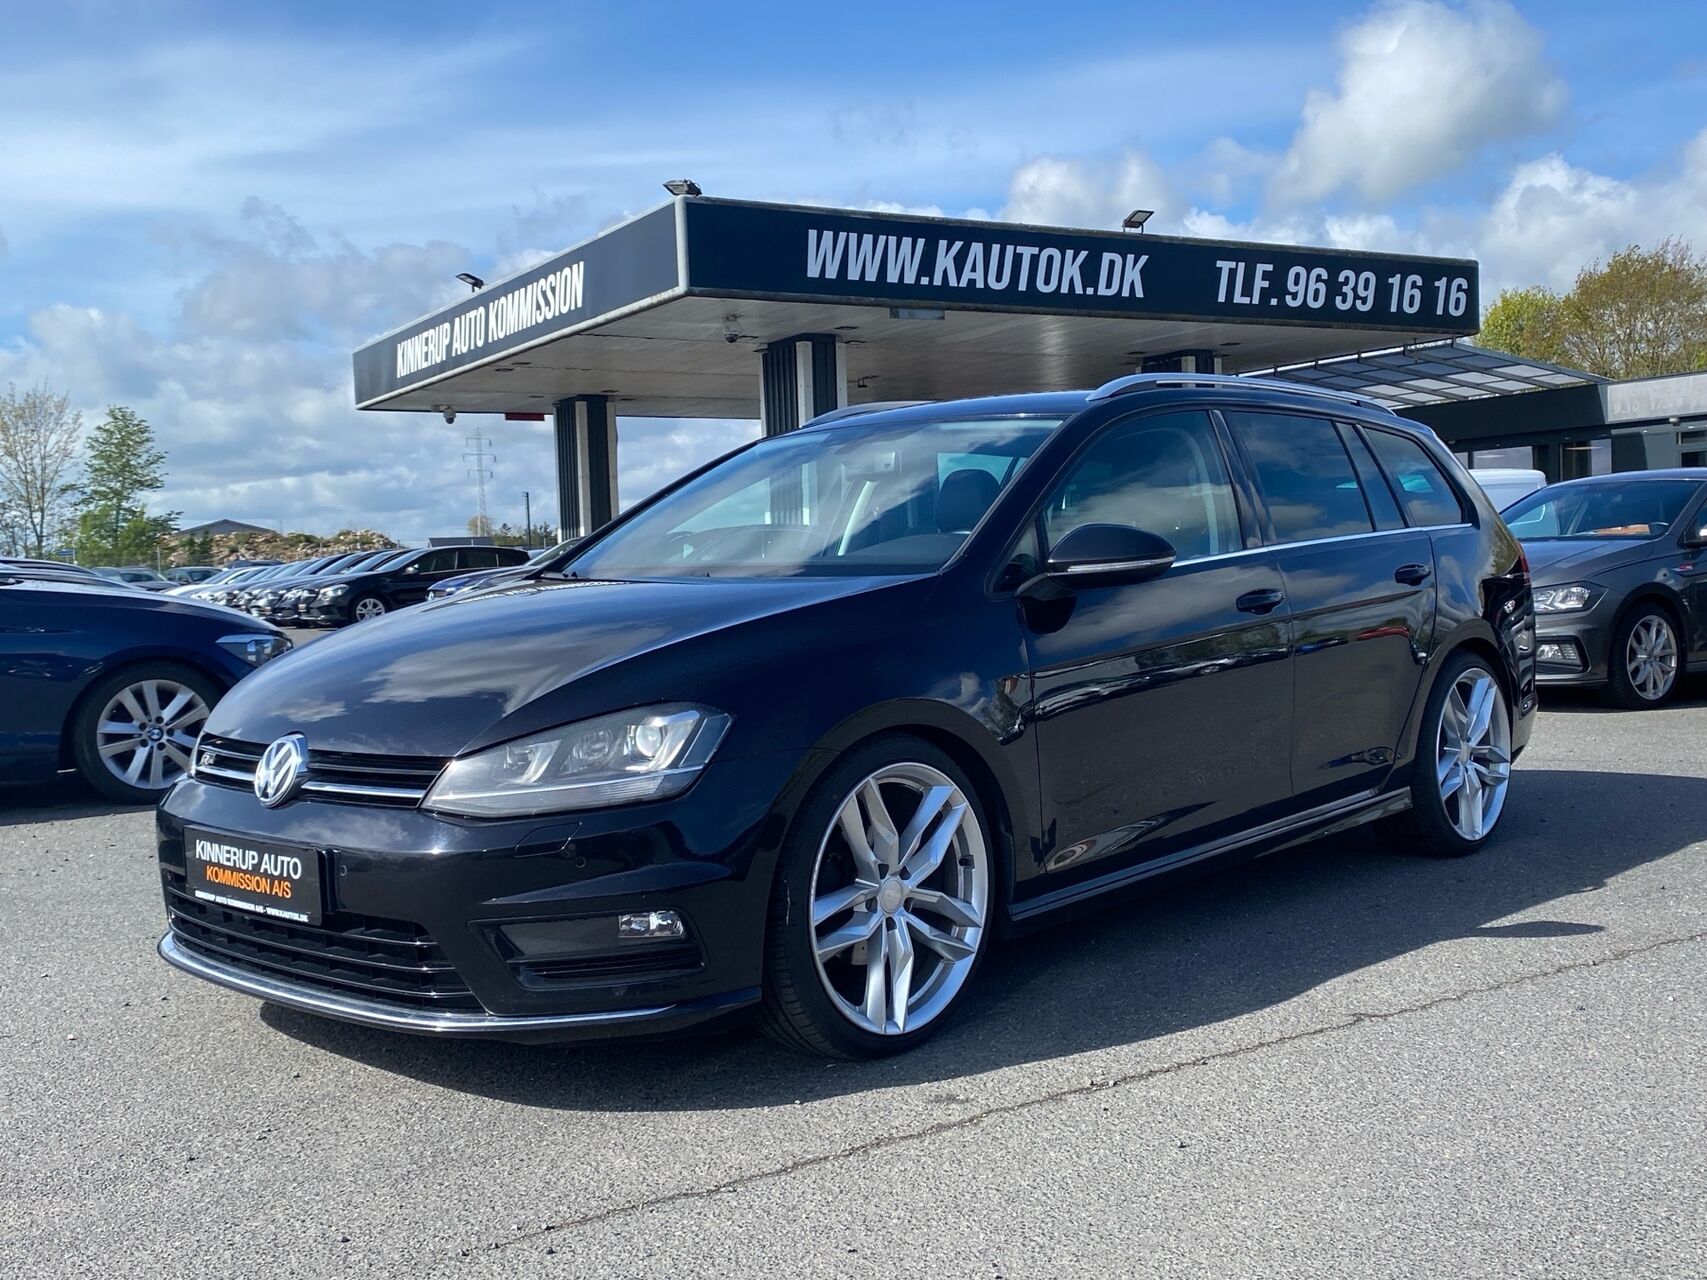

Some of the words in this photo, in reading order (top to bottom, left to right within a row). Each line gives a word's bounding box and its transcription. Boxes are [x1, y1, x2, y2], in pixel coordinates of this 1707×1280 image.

[807, 229, 1149, 298] WWW.KAUTOK.DK
[1215, 260, 1278, 306] TLF.
[1286, 265, 1328, 309] 96
[1335, 269, 1376, 312] 39
[1388, 273, 1423, 314] 16
[1434, 277, 1468, 317] 16
[396, 322, 450, 378] KINNERUP
[452, 306, 485, 357] AUTO
[488, 261, 584, 343] KOMMISSION
[195, 839, 258, 871] KINNERUP
[260, 853, 302, 880] AUTO
[206, 865, 270, 895] KOMMISSION
[272, 880, 292, 898] A/S
